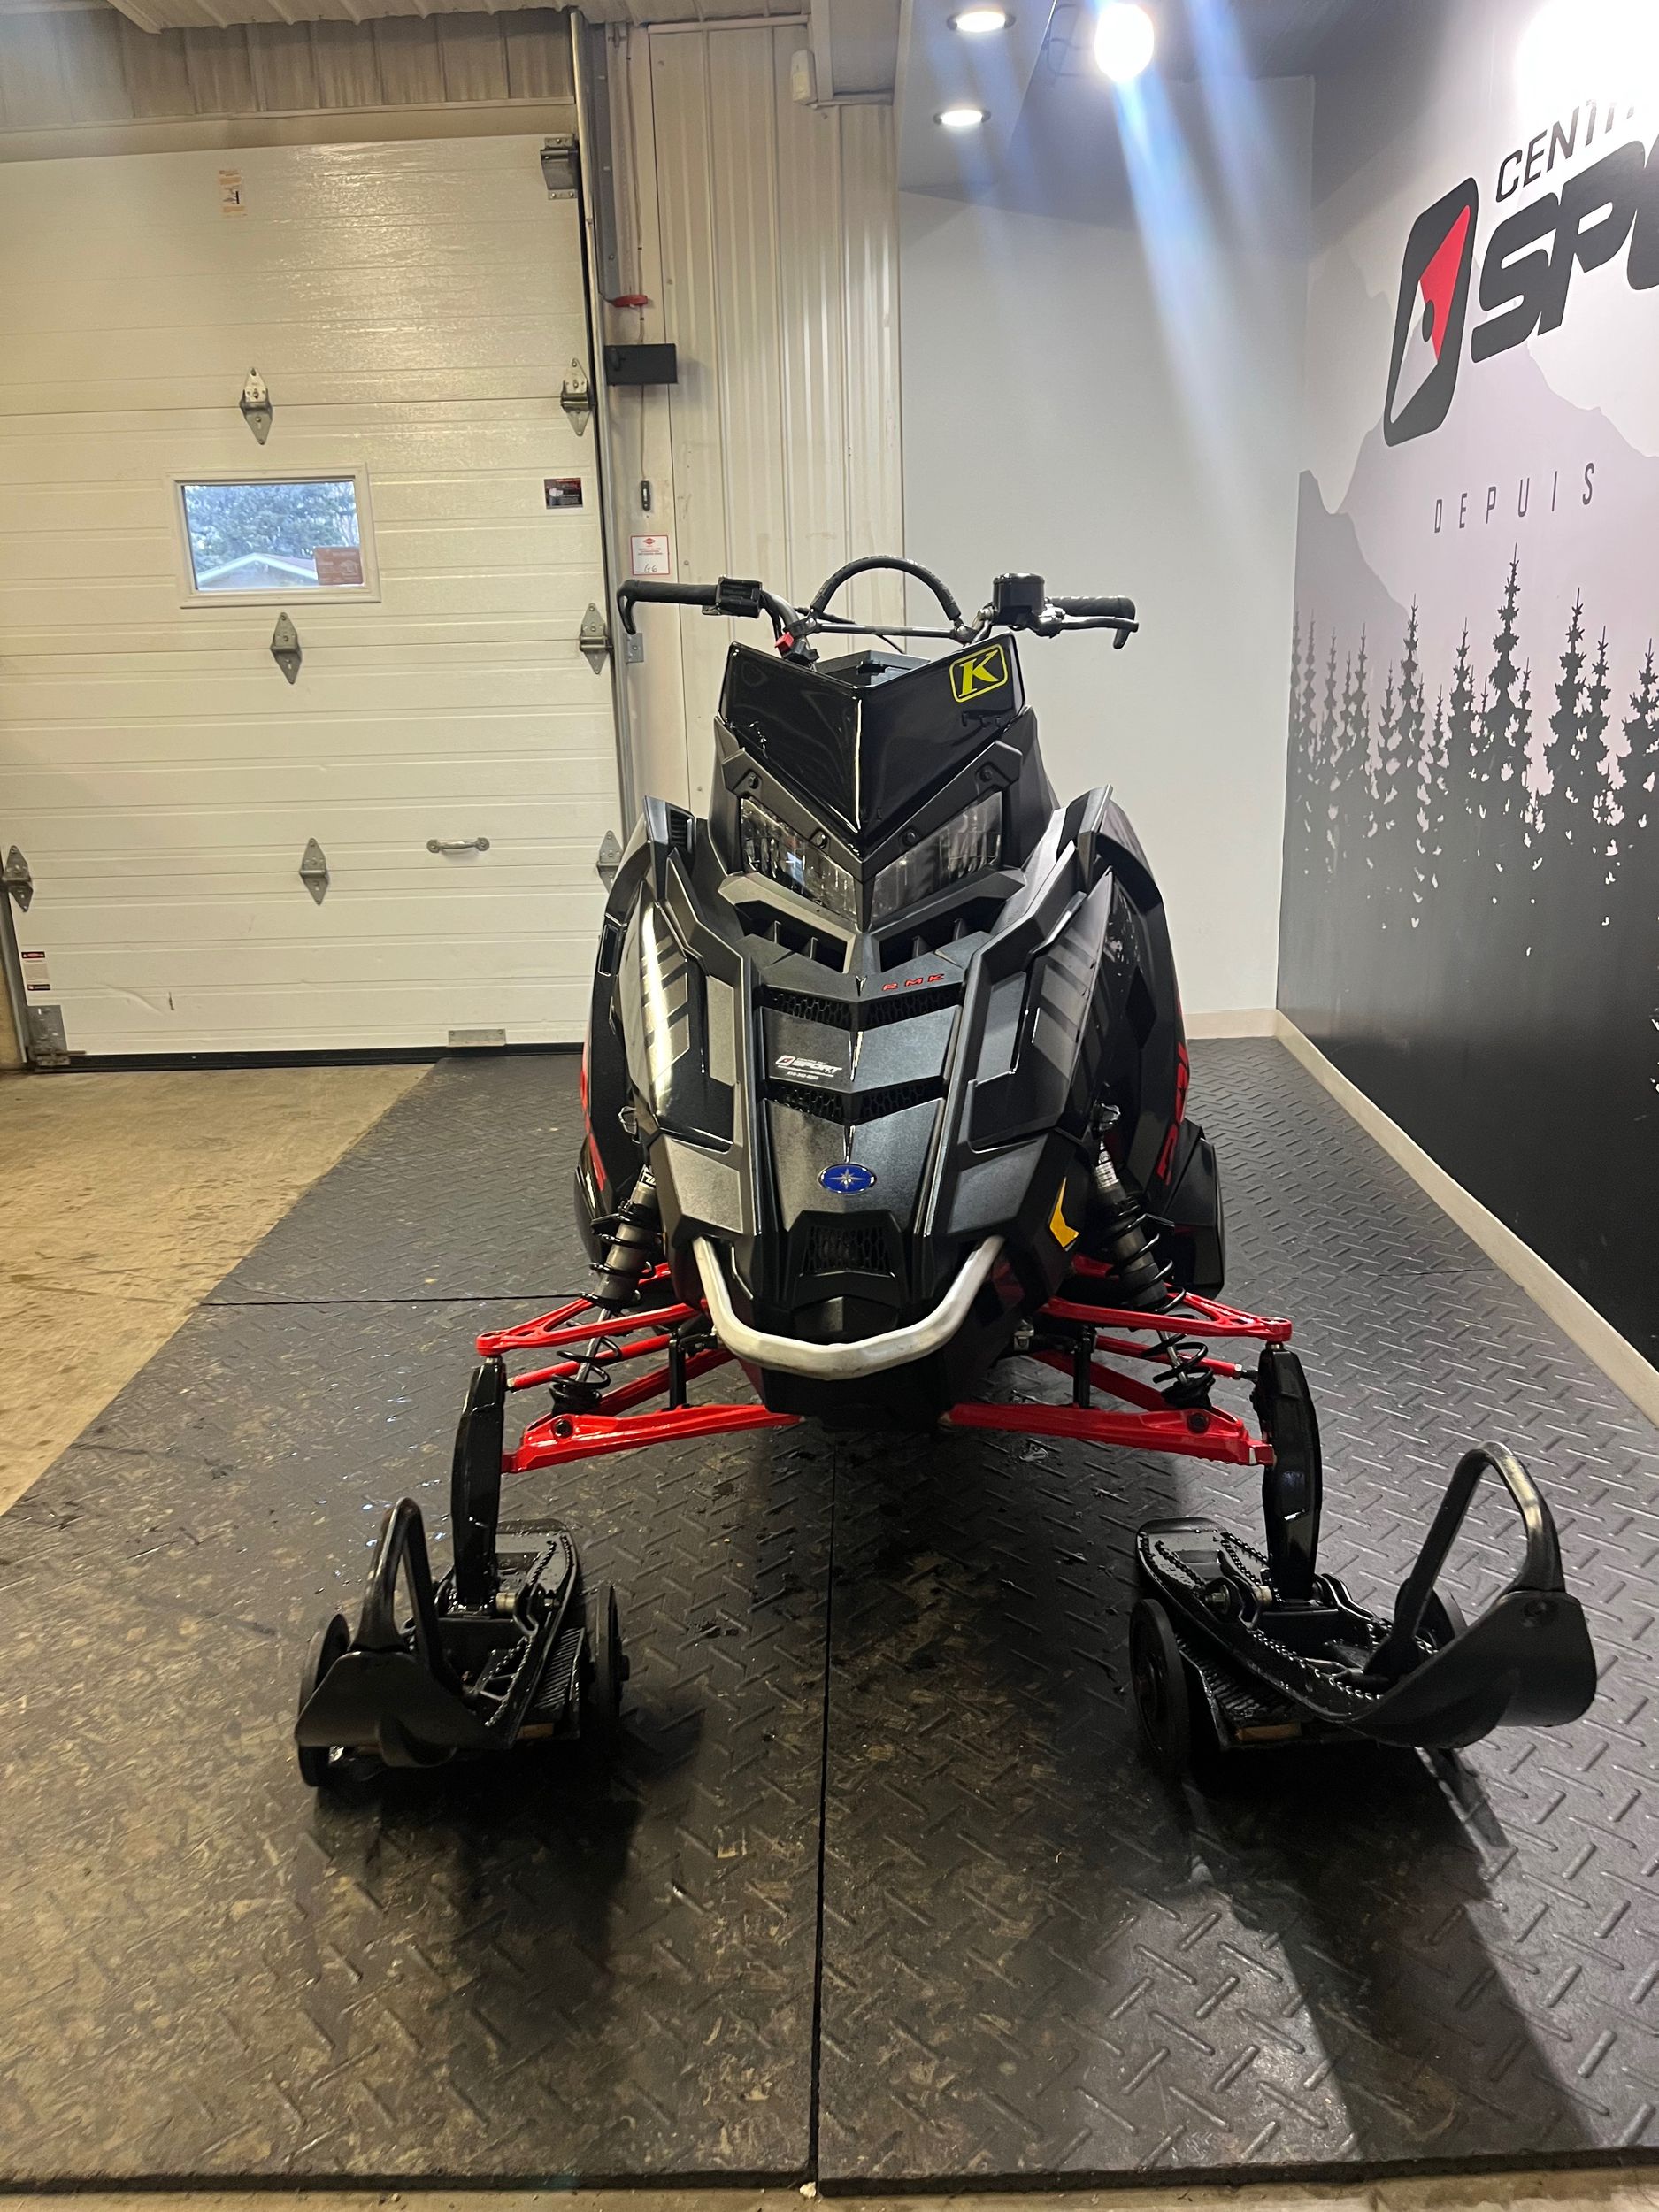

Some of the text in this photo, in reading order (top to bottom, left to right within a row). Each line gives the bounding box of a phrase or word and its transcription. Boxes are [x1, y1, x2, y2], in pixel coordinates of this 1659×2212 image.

[1433, 462, 1595, 534] DEPUIS
[958, 649, 1000, 698] K
[882, 973, 945, 992] RMK
